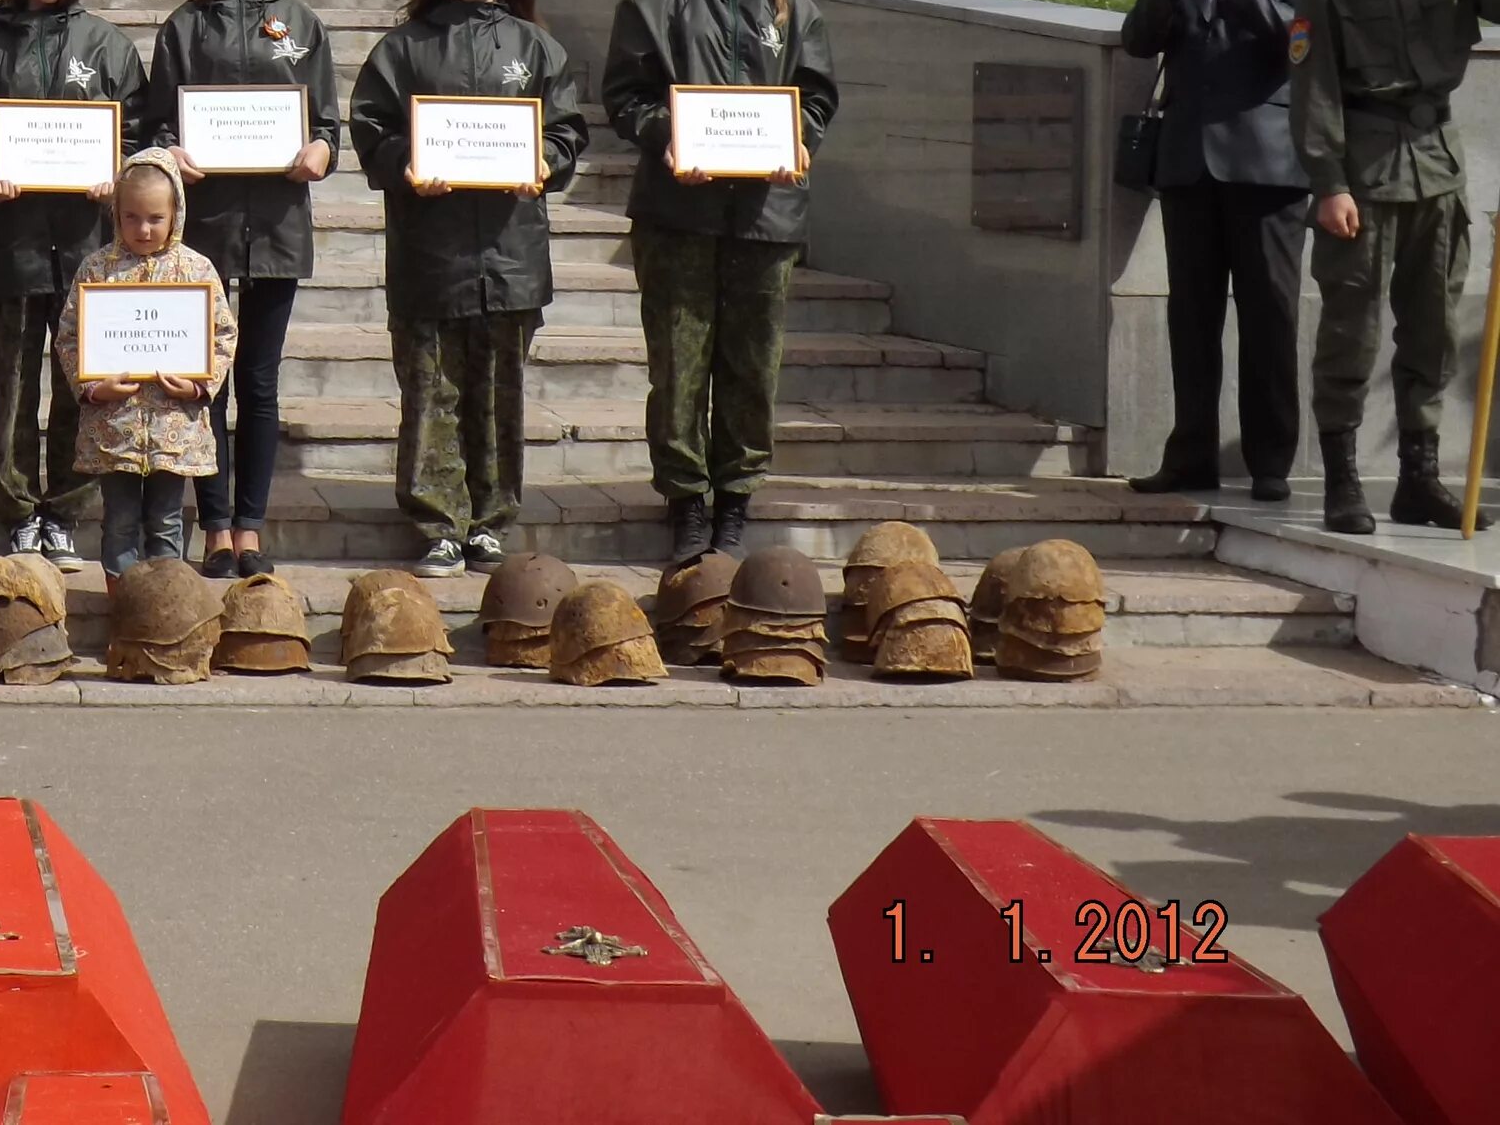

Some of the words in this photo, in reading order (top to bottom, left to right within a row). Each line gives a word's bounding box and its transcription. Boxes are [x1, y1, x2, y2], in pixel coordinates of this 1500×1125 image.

[709, 107, 761, 121] Ефимов
[445, 118, 507, 131] Угольков
[704, 125, 754, 137] Василий
[425, 136, 454, 149] Петр
[457, 137, 527, 149] Степанович
[134, 309, 159, 321] 210
[103, 329, 189, 339] НЕИЗВЕСТНЫХ
[122, 343, 170, 353] СОЛДАТ
